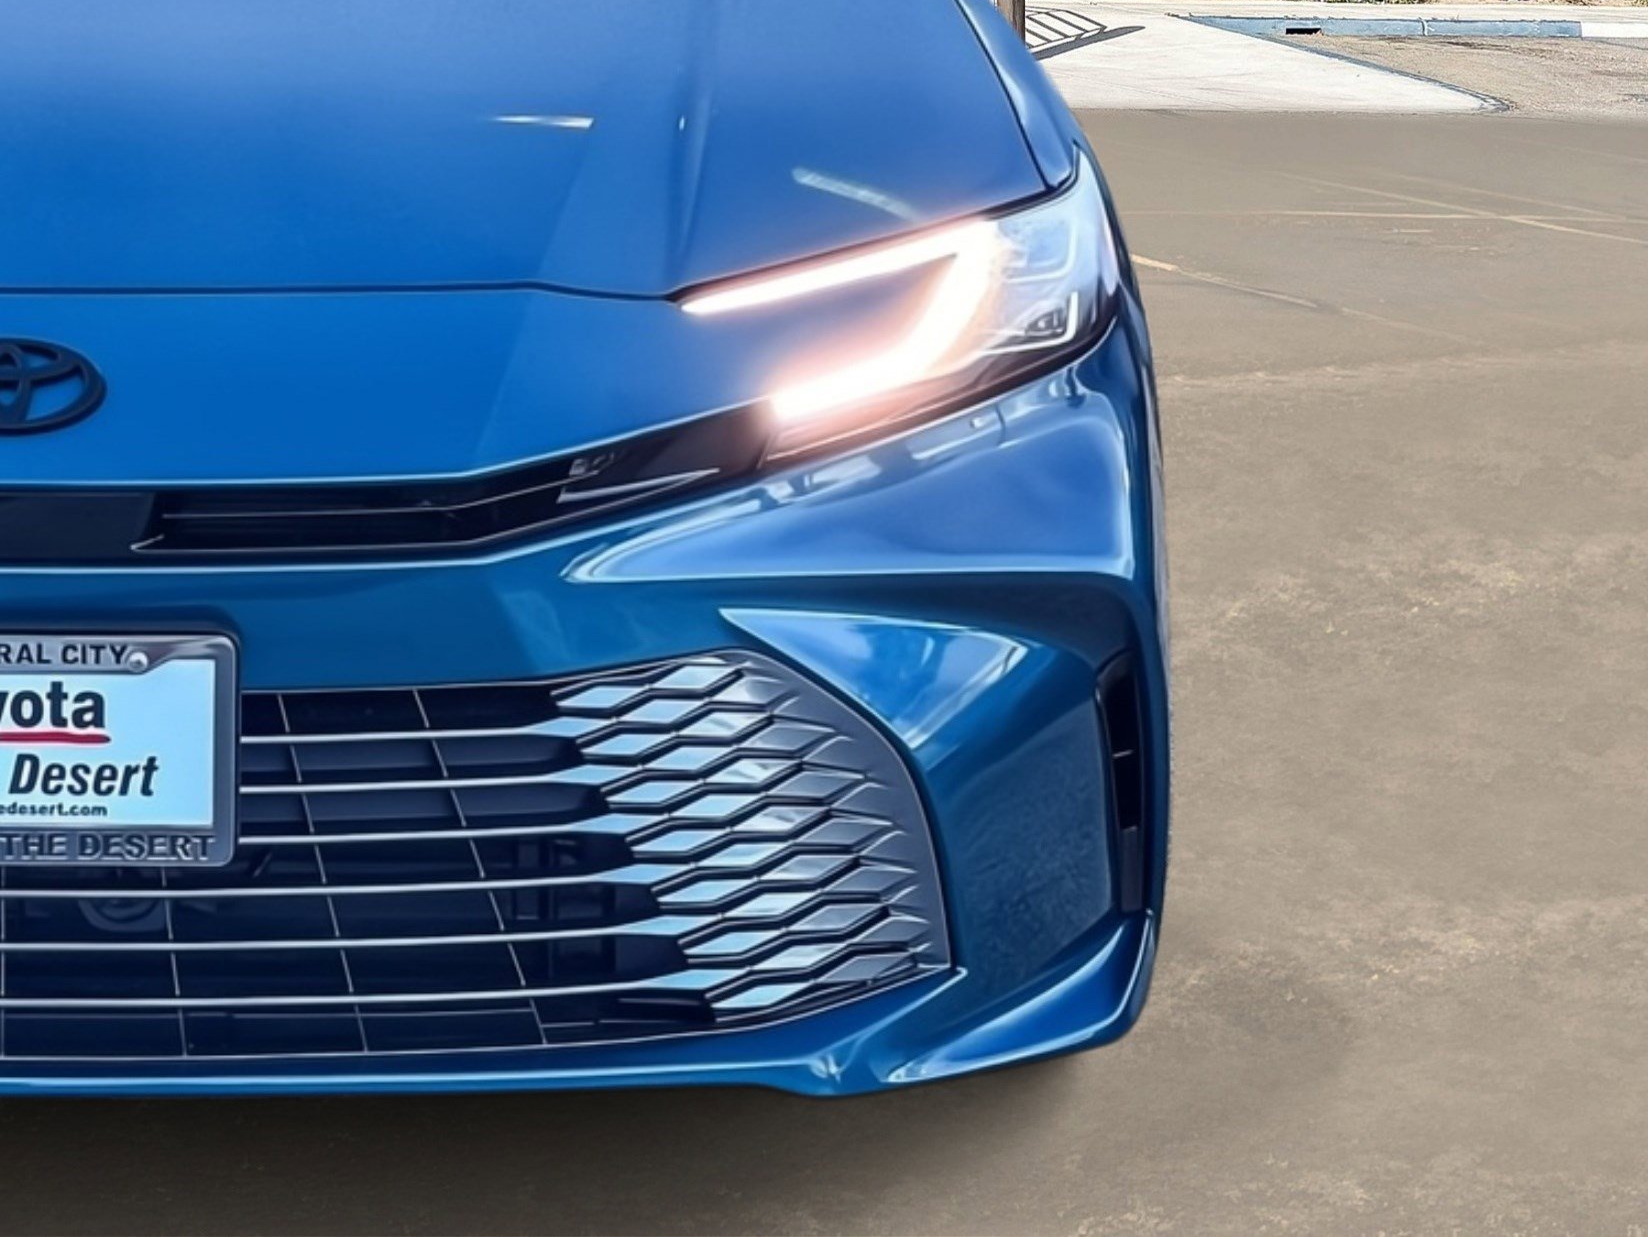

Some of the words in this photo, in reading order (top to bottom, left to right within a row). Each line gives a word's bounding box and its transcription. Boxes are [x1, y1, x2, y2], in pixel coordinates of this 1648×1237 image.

[61, 644, 128, 665] CITY
[8, 753, 159, 797] Desert
[77, 832, 216, 860] DESERT
